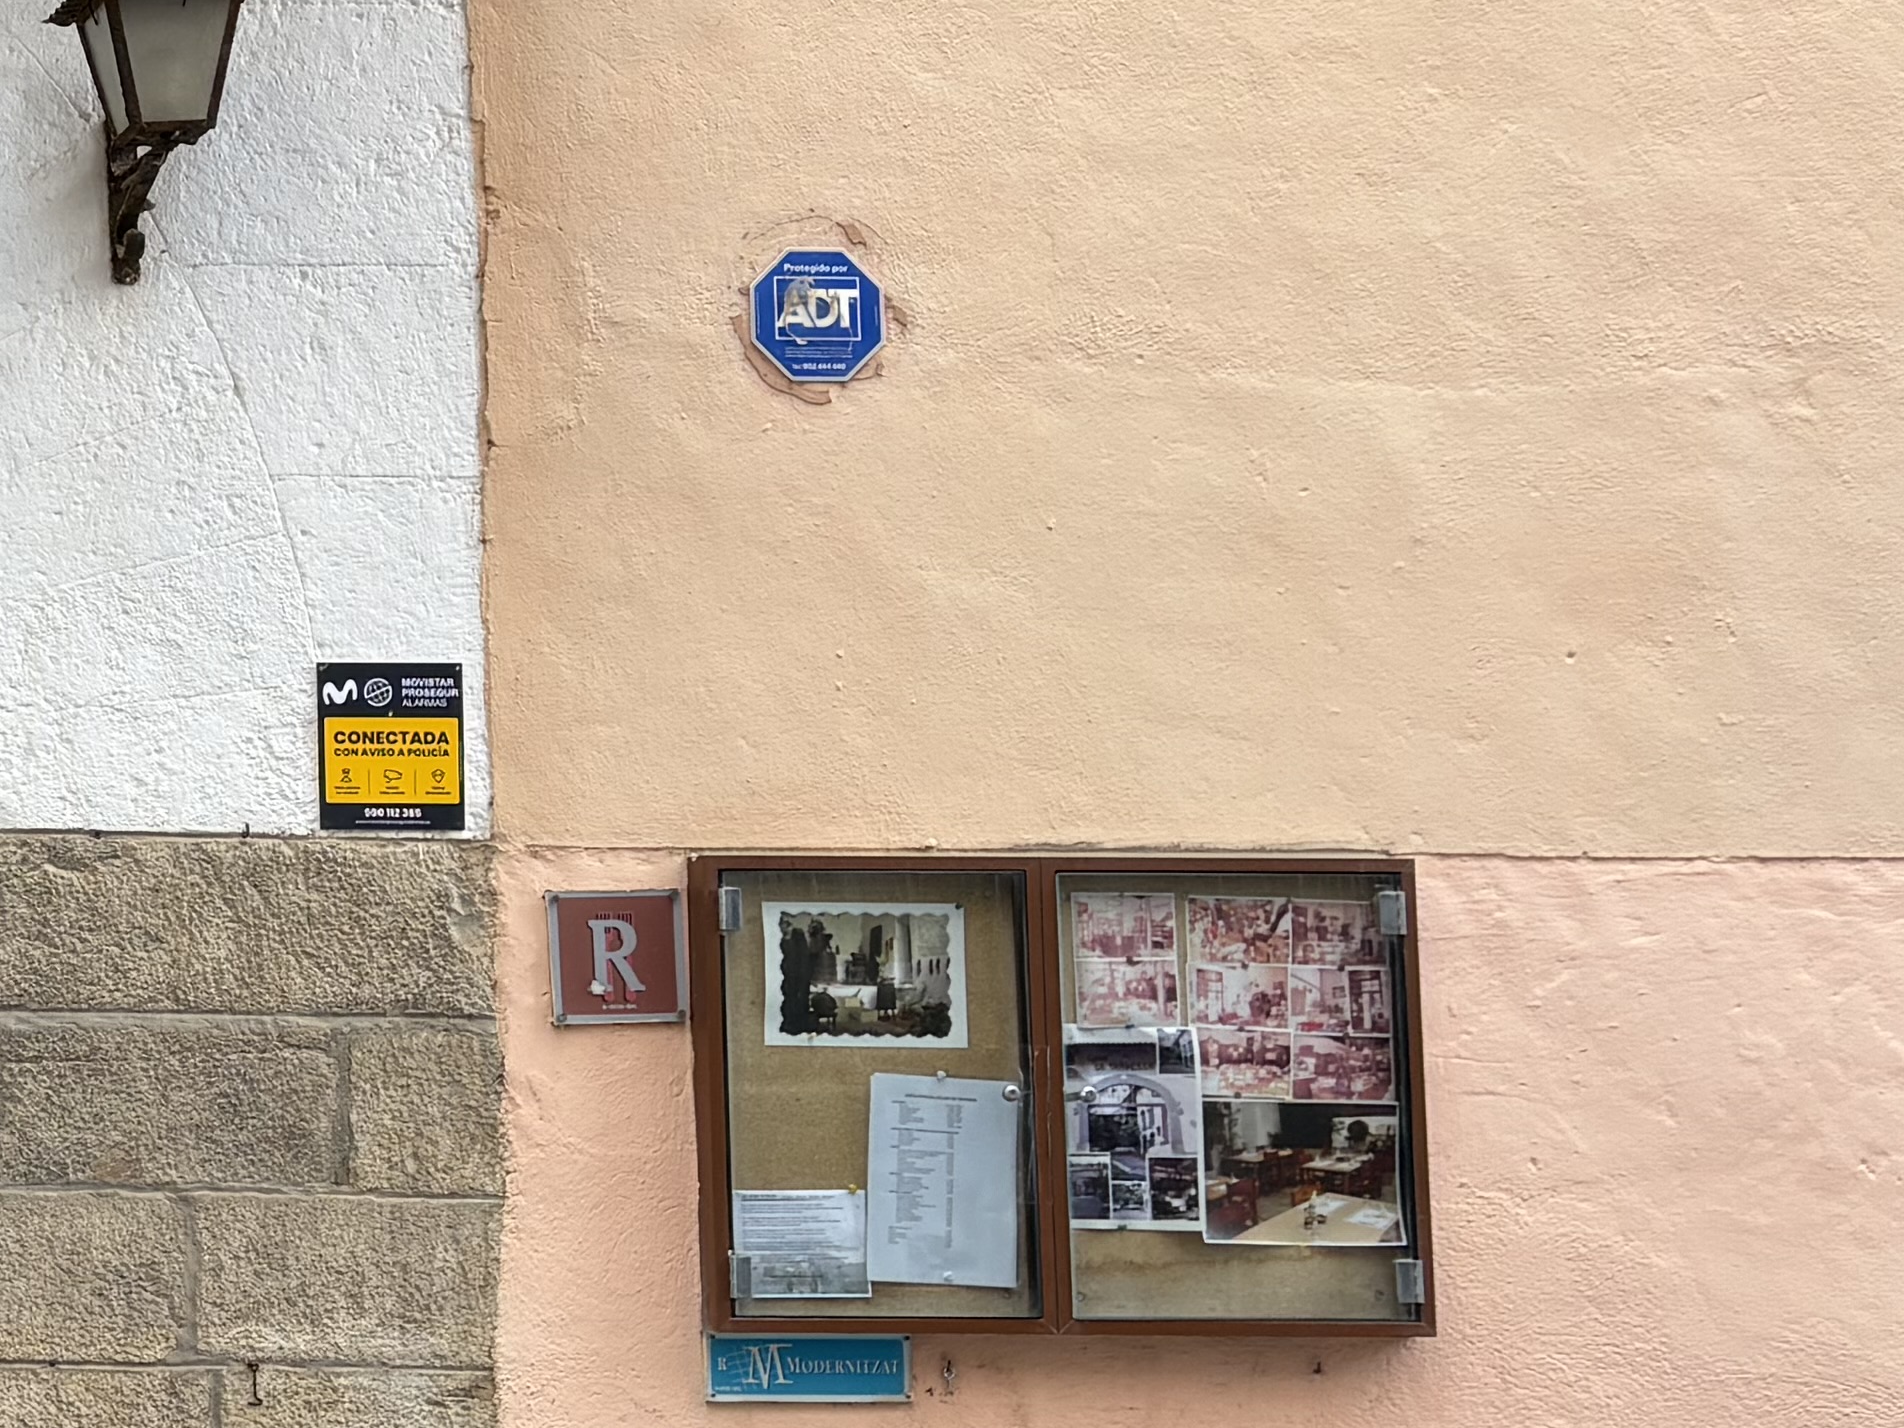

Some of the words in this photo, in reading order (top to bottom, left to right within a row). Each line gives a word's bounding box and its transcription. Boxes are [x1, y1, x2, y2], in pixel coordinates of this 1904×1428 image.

[783, 263, 831, 274] Protegido
[832, 265, 849, 274] por
[777, 288, 859, 328] ADT
[401, 677, 455, 687] MOVISTAR
[401, 688, 459, 698] PROSEGUR
[333, 730, 450, 745] CONECTADA
[333, 748, 359, 757] CON
[360, 748, 396, 757] AVISO
[397, 748, 405, 757] A
[407, 746, 450, 758] POLICÍA
